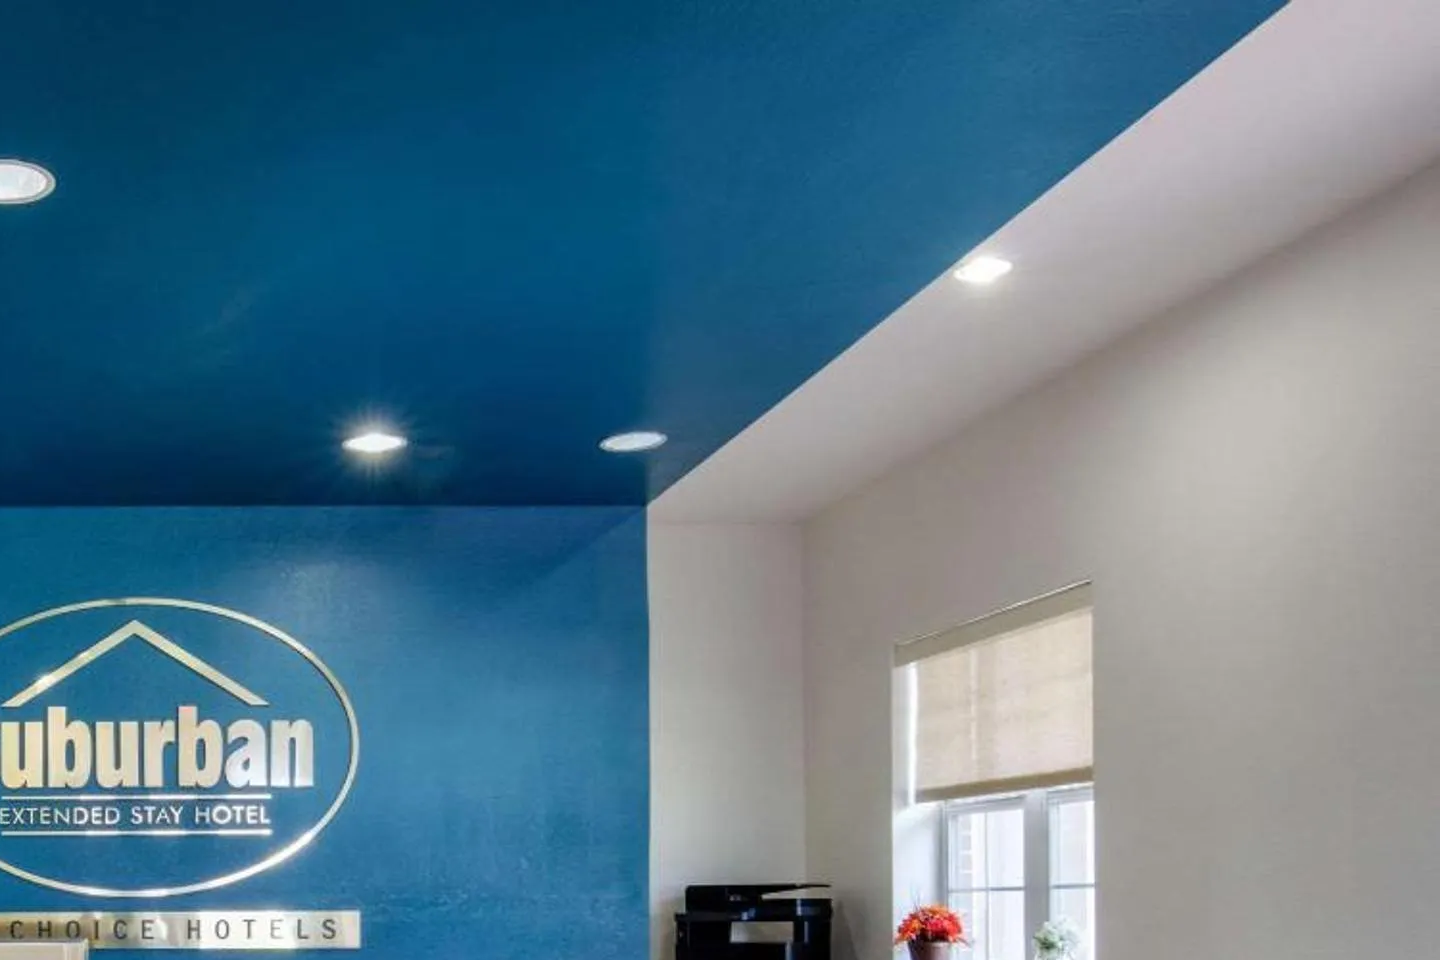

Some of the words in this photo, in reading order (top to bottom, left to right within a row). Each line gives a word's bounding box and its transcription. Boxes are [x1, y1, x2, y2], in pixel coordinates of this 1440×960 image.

[130, 805, 184, 825] STAY
[194, 804, 272, 825] HOTEL
[9, 918, 155, 941] CHOICE
[187, 918, 338, 941] HOTELS
